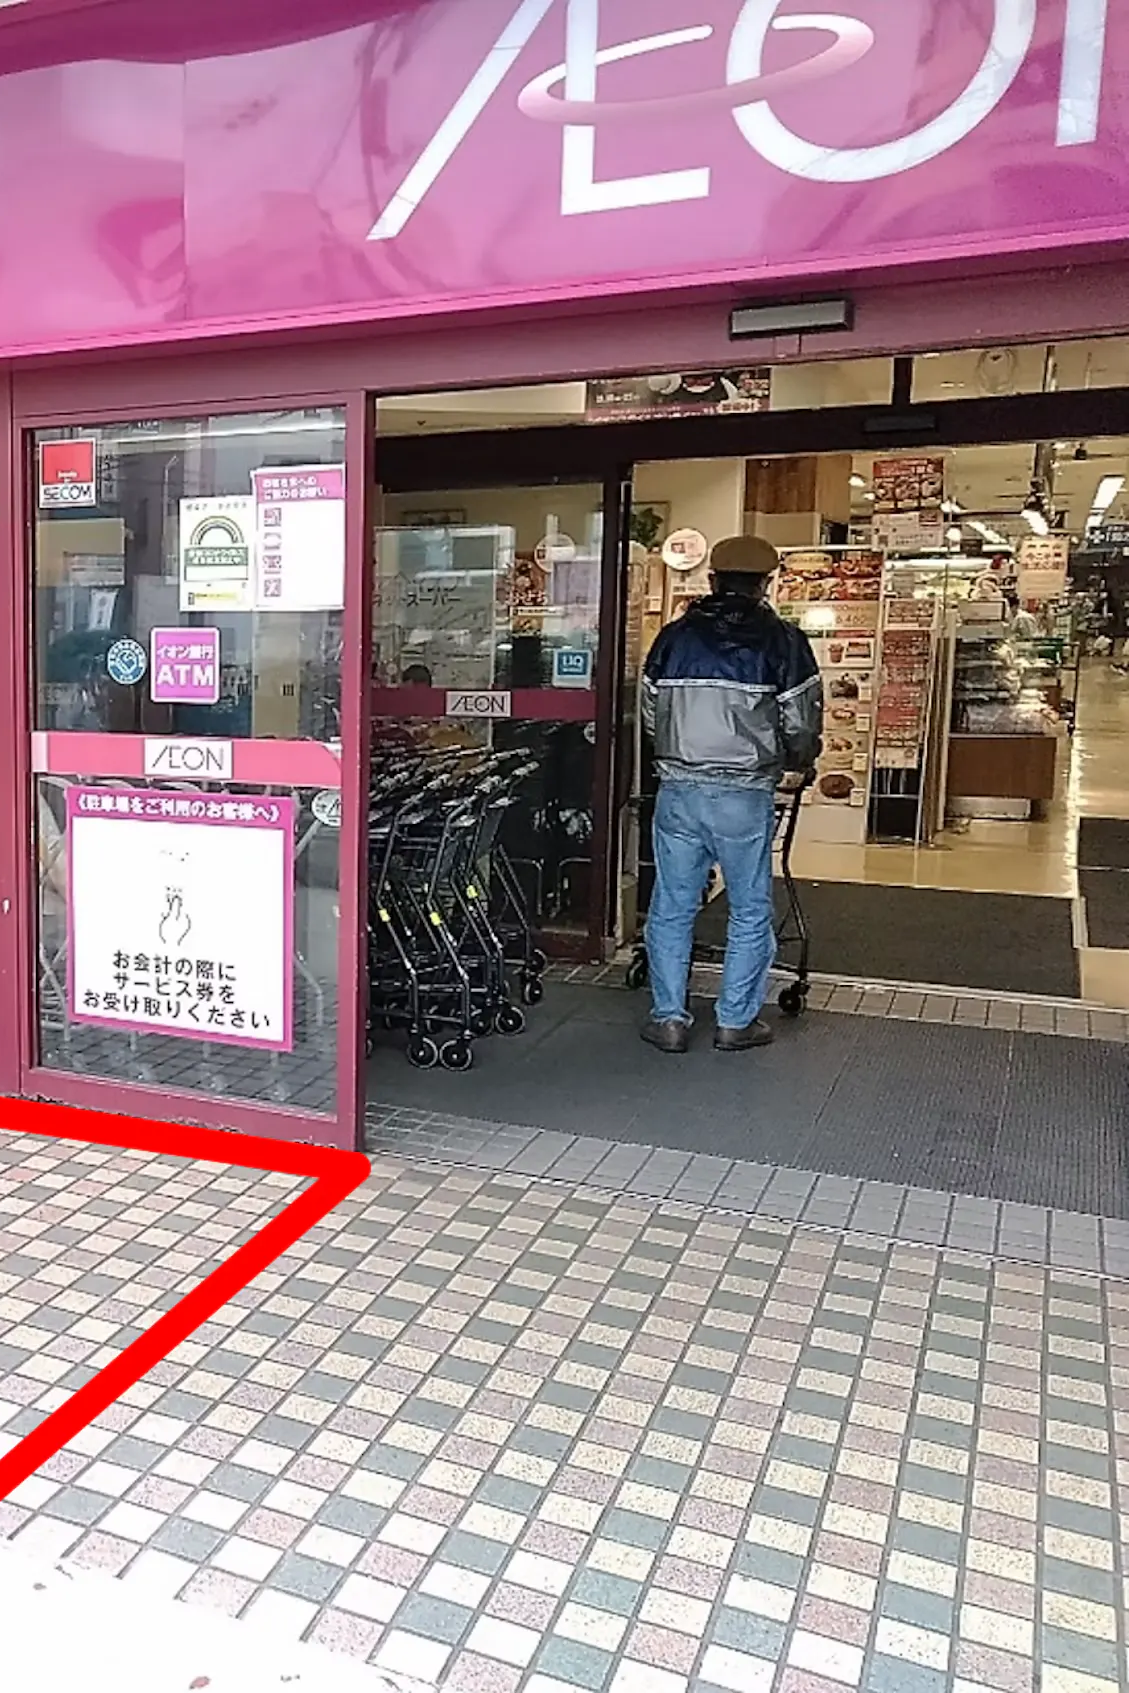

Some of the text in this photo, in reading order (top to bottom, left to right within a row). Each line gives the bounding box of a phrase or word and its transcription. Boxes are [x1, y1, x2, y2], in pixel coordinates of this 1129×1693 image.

[43, 485, 93, 500] SECOM
[156, 645, 214, 660] イオン銀行
[156, 663, 214, 687] ATM
[113, 949, 237, 982] お会計の際に
[113, 972, 236, 1005] サービス券を
[82, 989, 271, 1030] お受け取りください
